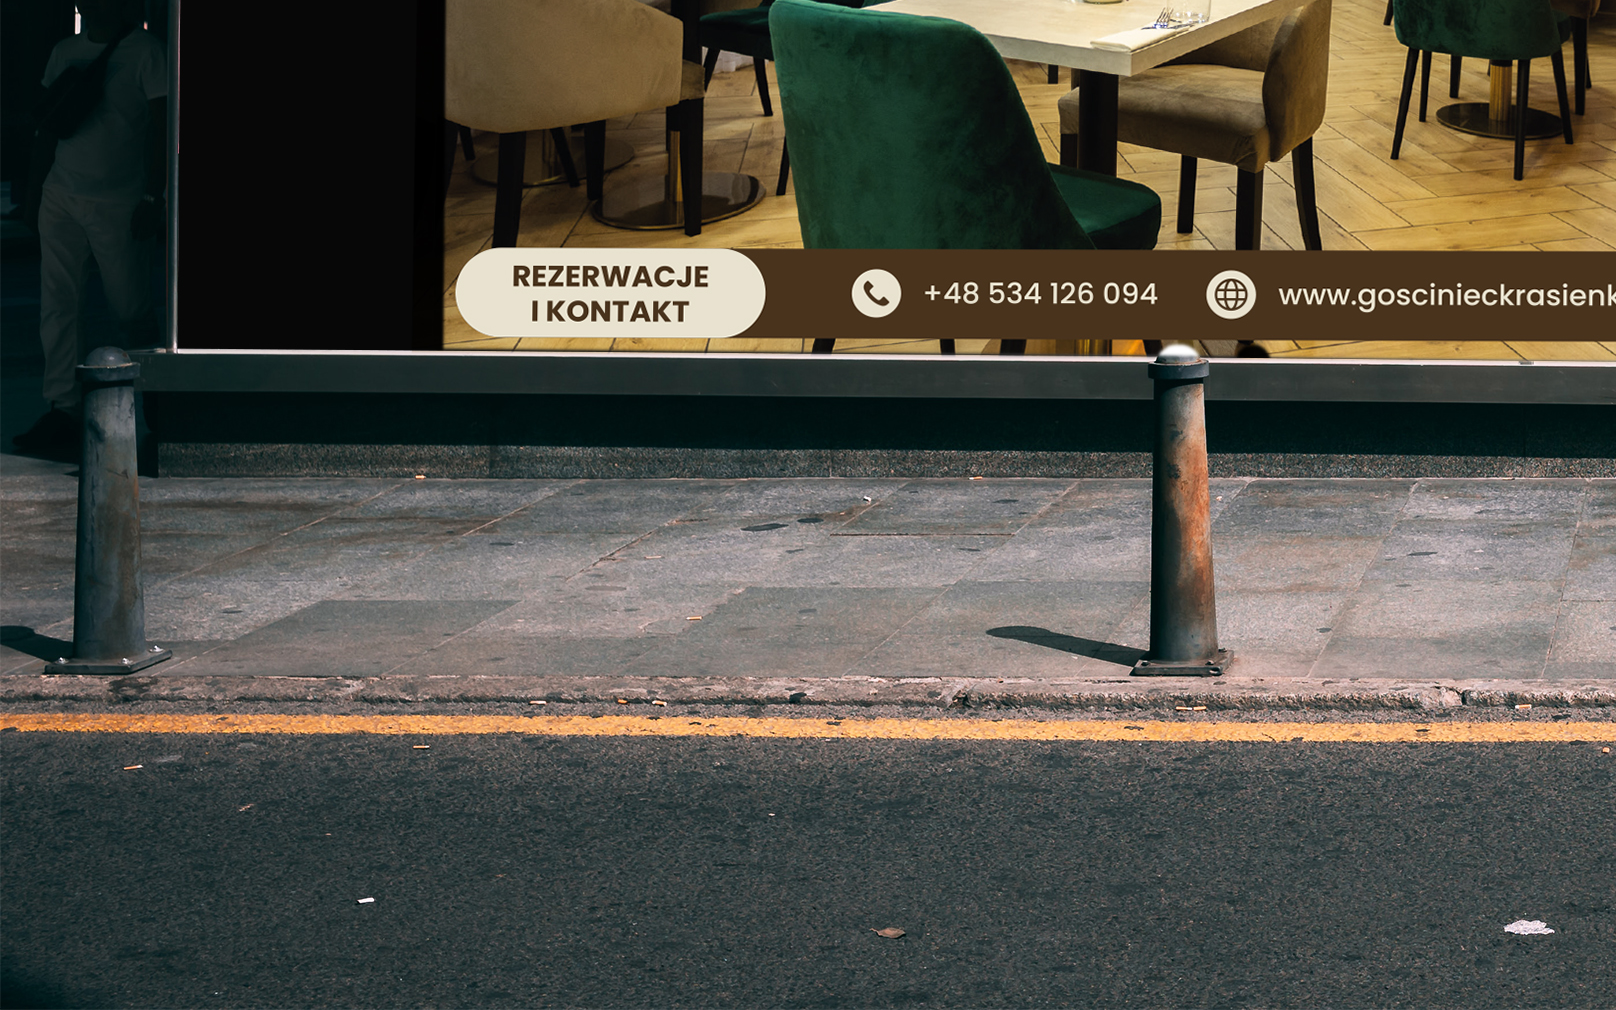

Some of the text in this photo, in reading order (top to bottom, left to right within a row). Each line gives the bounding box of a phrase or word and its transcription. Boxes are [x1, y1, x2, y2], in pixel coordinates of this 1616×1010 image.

[512, 265, 709, 288] REZERWACJE
[924, 281, 1158, 305] +48 534 126 094
[531, 299, 690, 323] I KONTAKT
